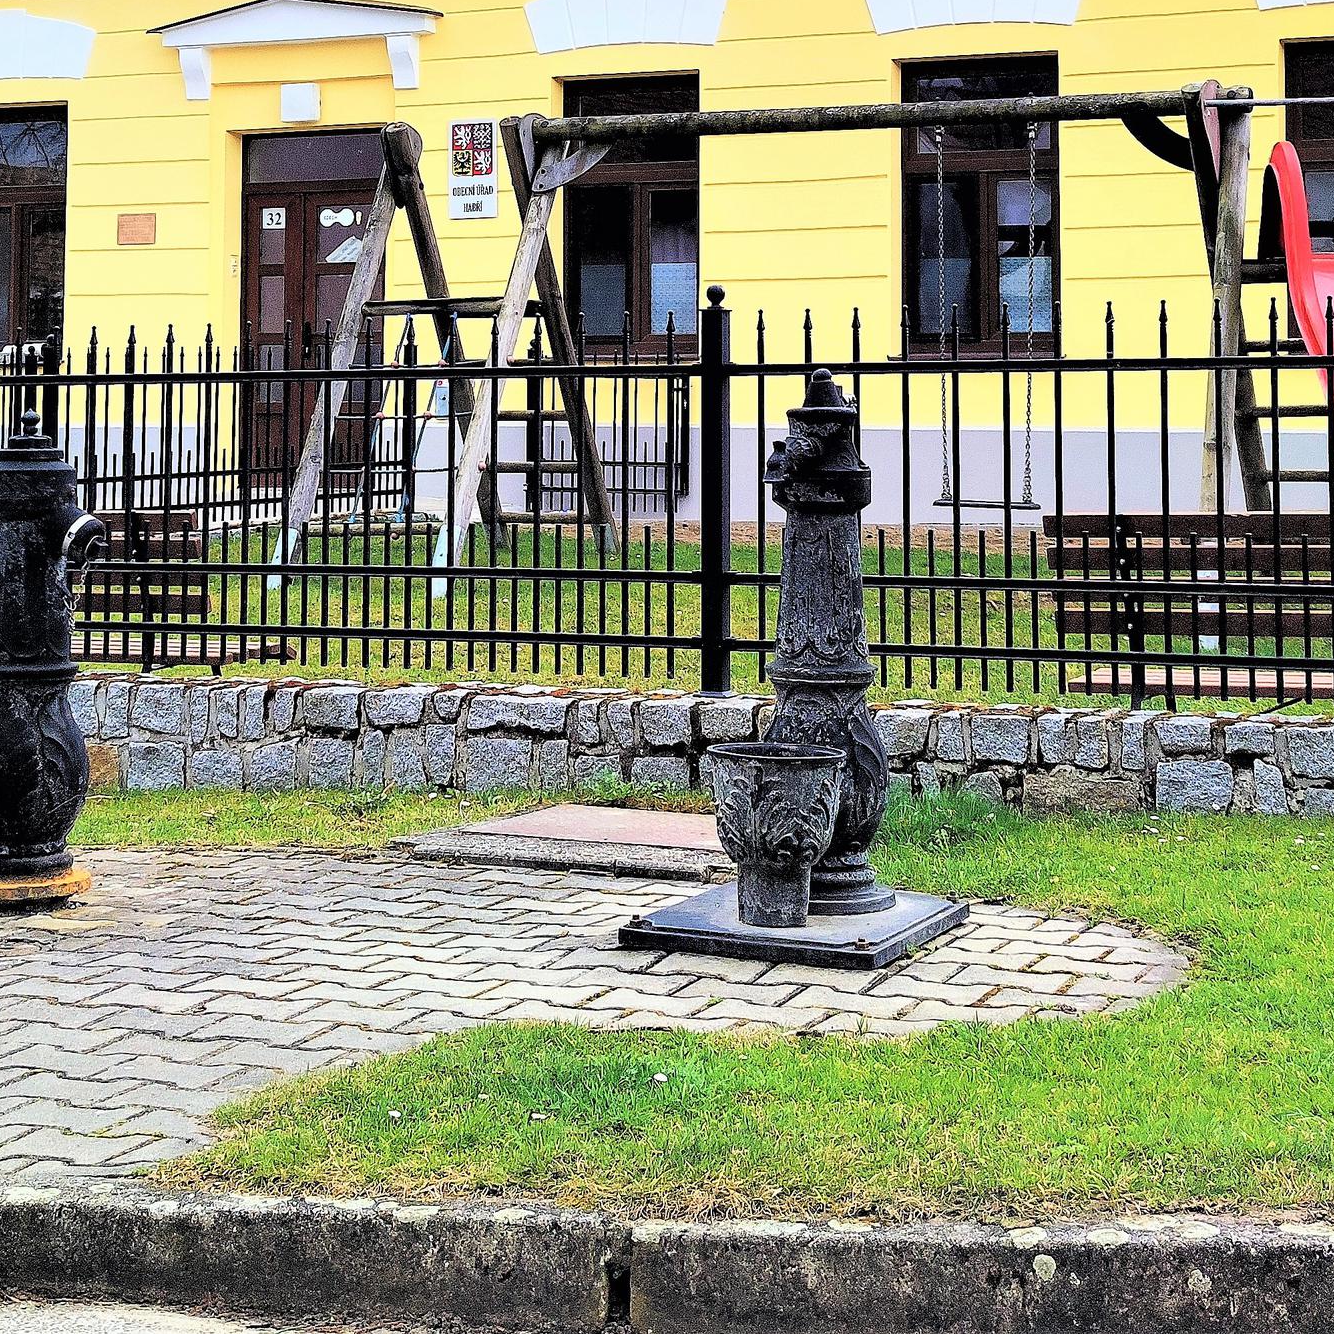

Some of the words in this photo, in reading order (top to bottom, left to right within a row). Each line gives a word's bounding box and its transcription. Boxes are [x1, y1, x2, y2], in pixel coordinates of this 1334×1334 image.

[452, 184, 475, 197] OBECNÍ
[476, 183, 494, 196] ÚŘAD
[266, 212, 282, 226] 32
